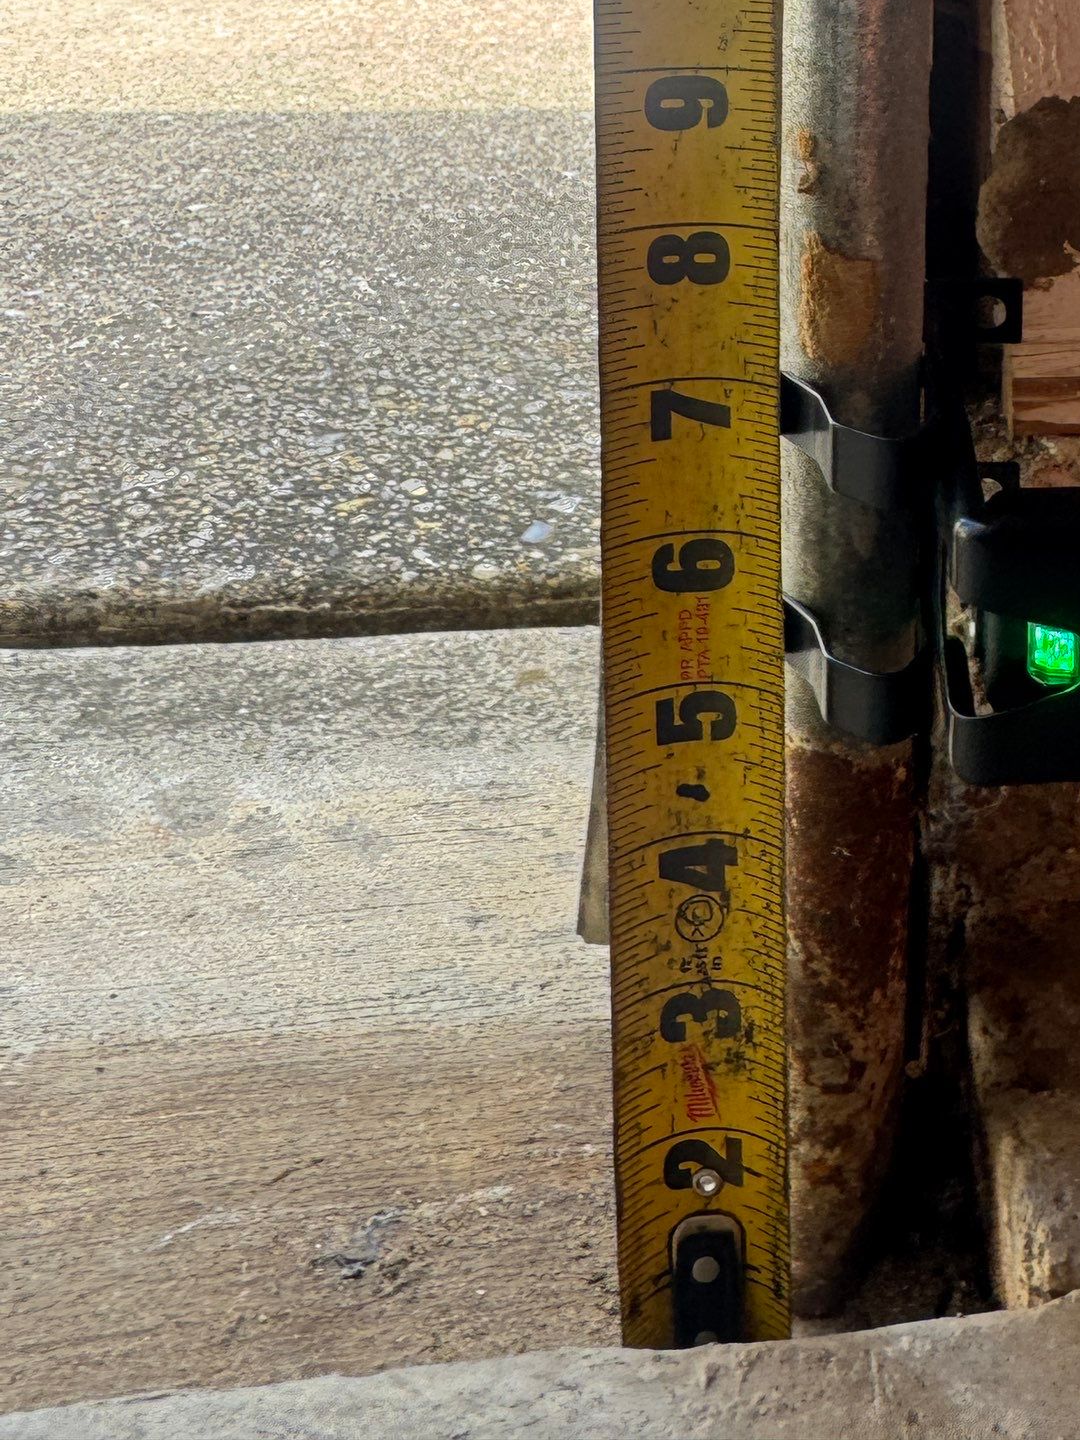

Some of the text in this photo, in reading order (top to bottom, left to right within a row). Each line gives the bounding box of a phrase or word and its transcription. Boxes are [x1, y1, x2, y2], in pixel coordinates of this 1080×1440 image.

[644, 75, 729, 132] 9
[646, 230, 731, 286] 8
[650, 390, 732, 442] 7
[651, 538, 735, 593] 6
[656, 690, 737, 746] 5
[658, 838, 739, 893] 4
[659, 987, 742, 1043] 3
[663, 1137, 744, 1191] 2
